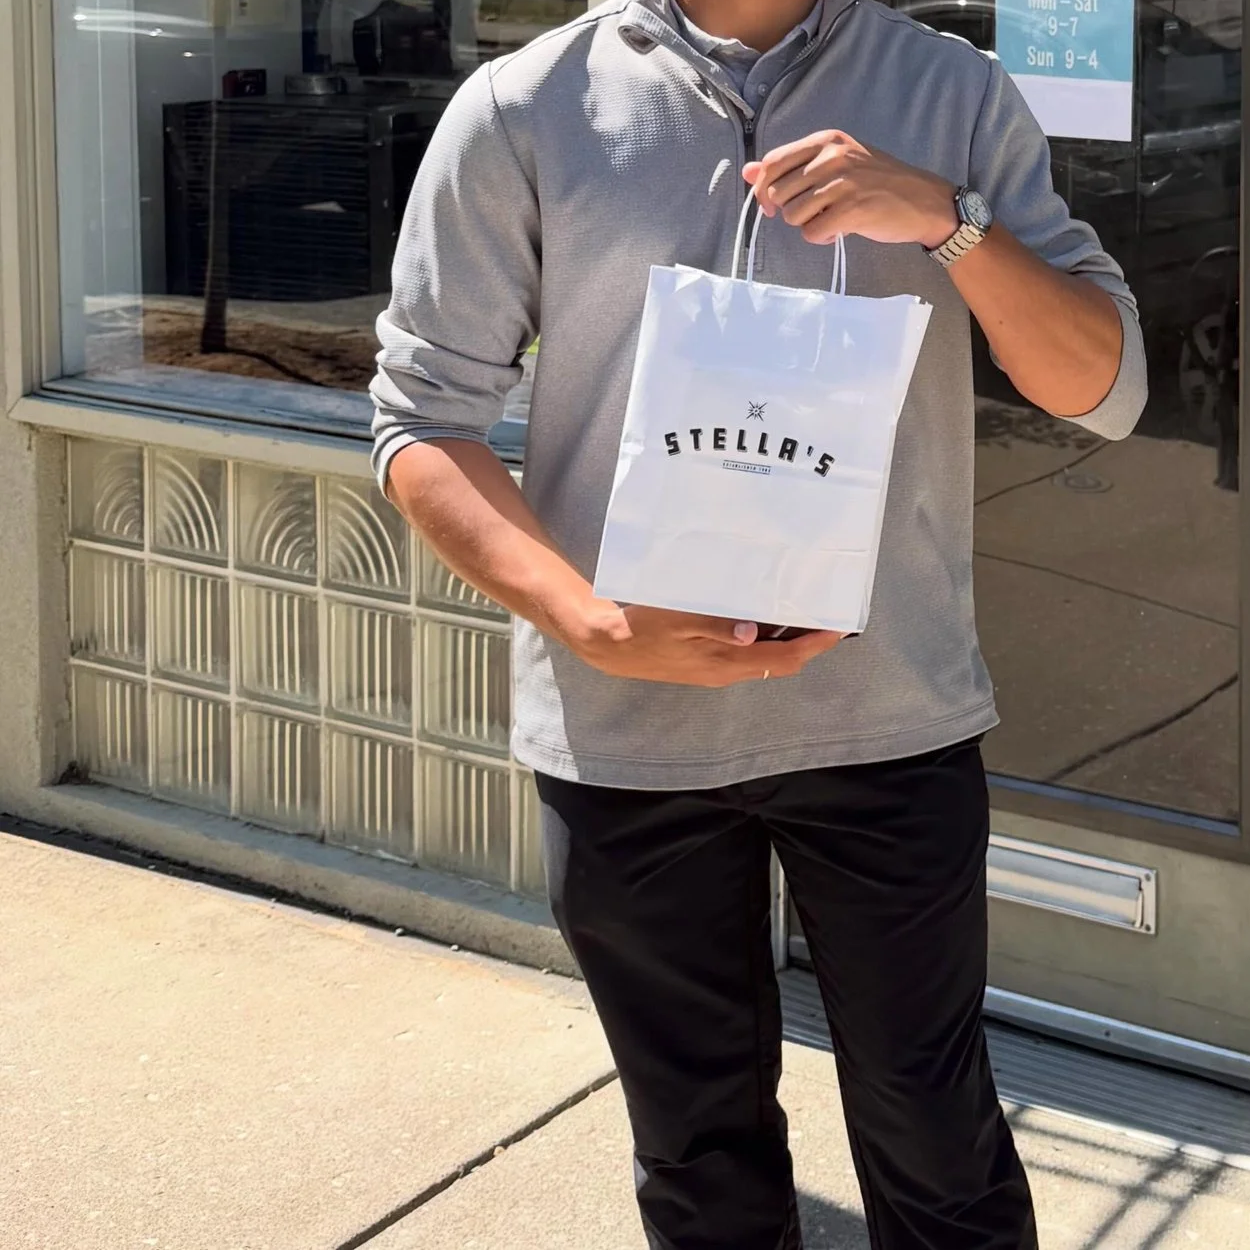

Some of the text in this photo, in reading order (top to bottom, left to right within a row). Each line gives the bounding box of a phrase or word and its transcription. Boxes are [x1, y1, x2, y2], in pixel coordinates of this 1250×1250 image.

[1048, 16, 1079, 37] 9-7
[1027, 46, 1098, 69] Sun 9-4
[664, 427, 835, 477] STELLA'S
